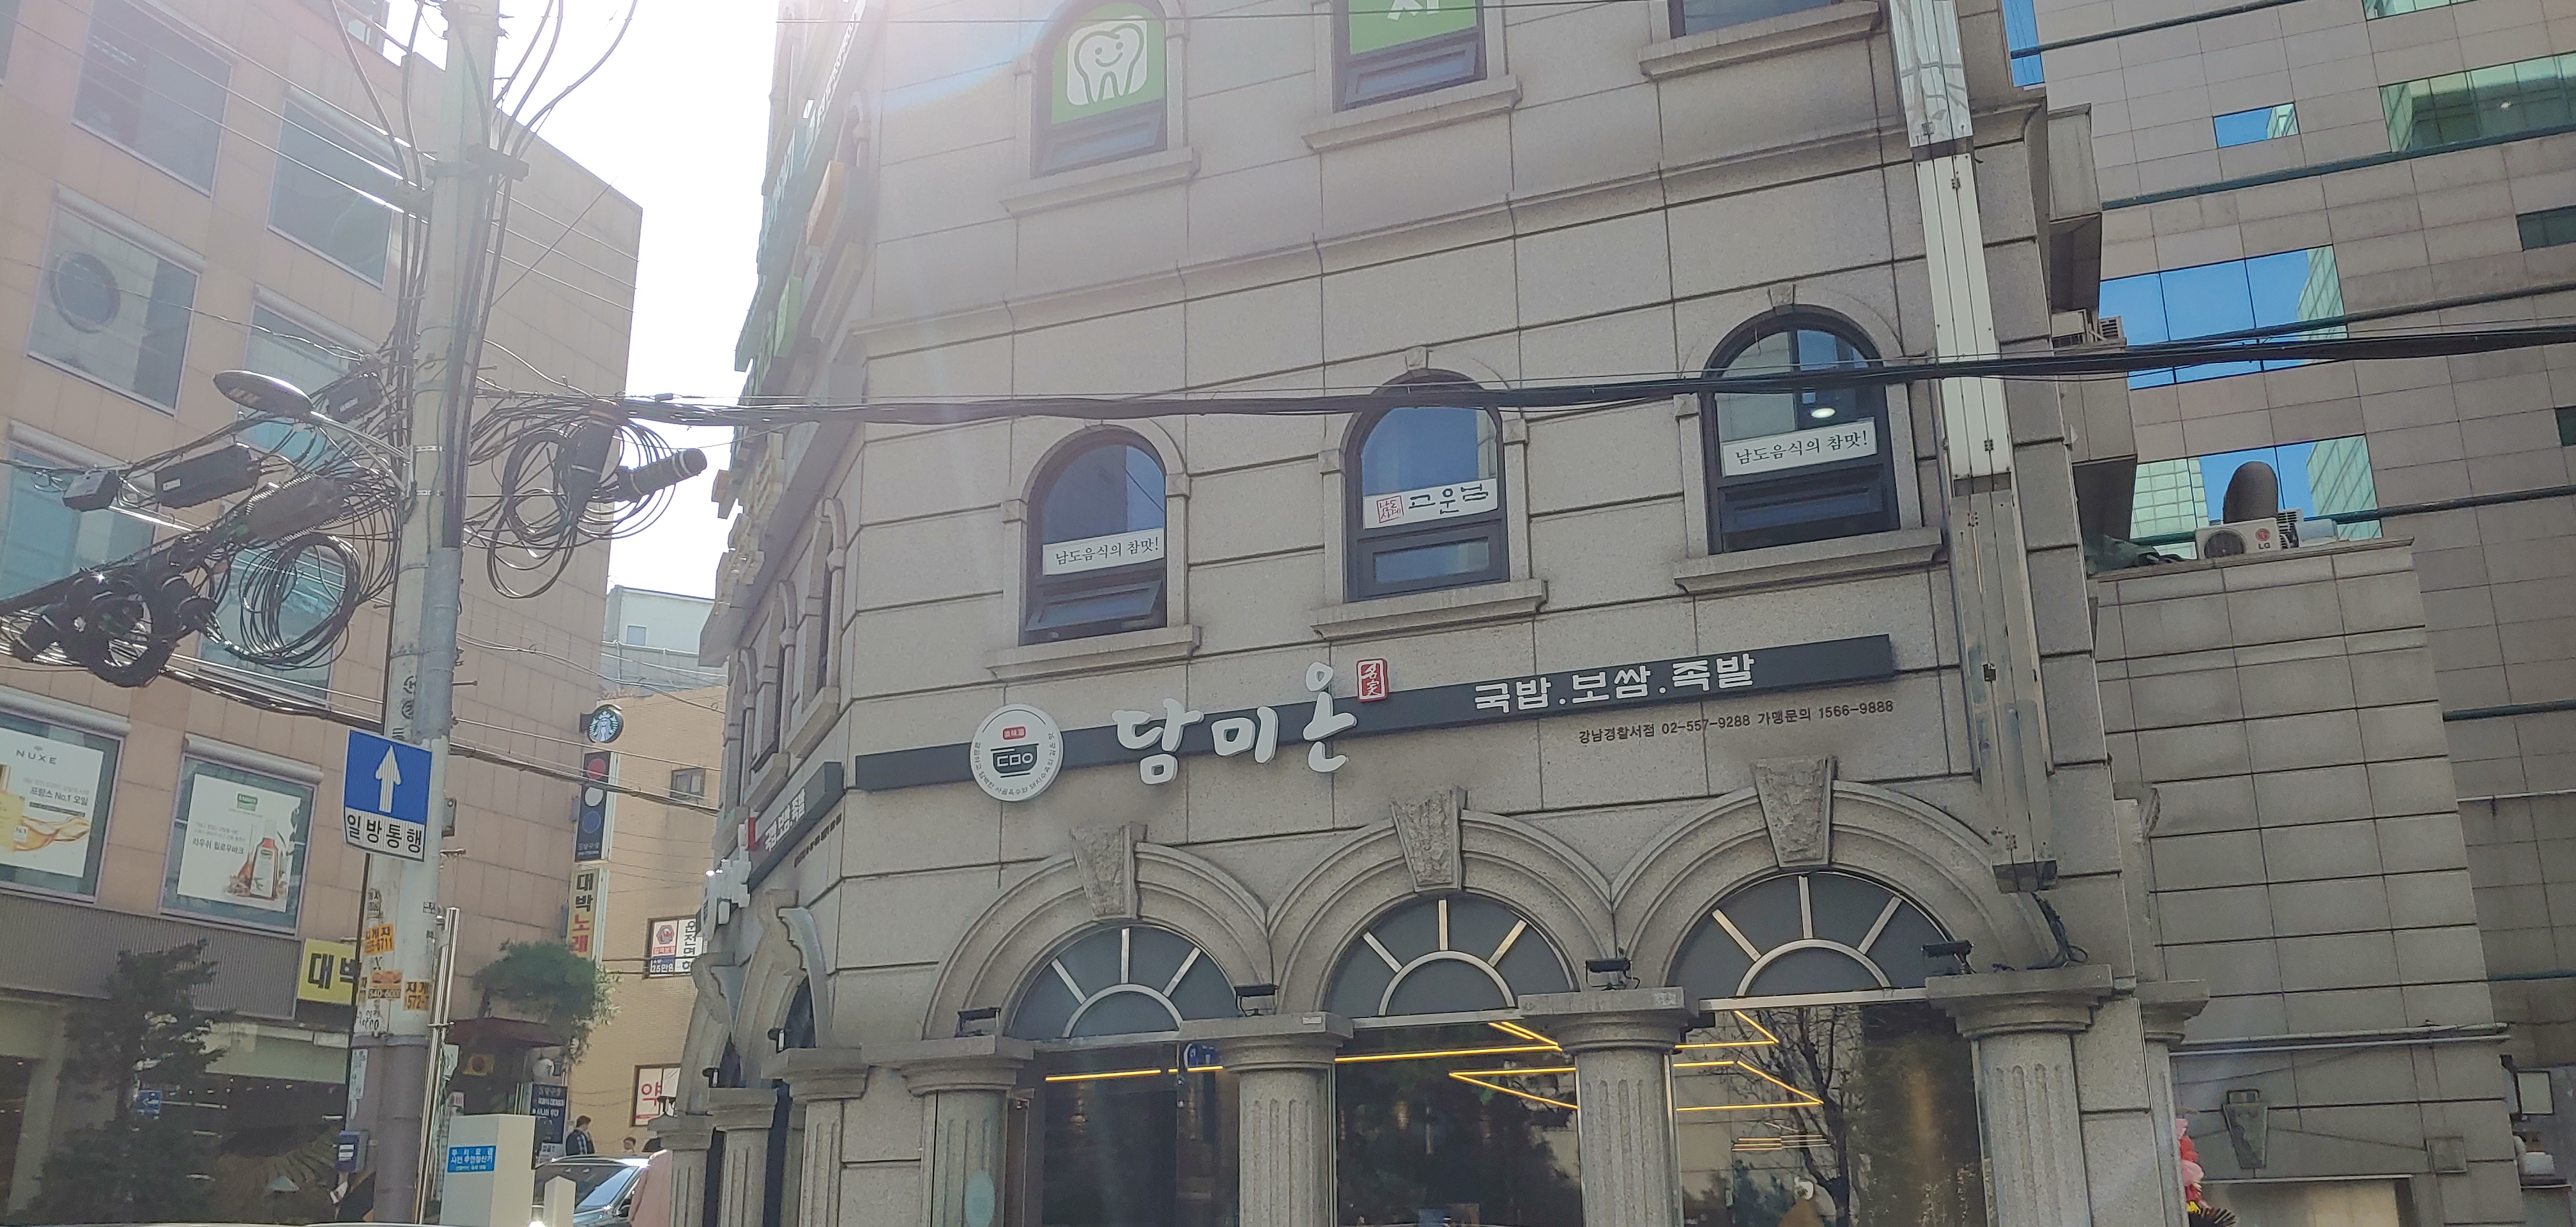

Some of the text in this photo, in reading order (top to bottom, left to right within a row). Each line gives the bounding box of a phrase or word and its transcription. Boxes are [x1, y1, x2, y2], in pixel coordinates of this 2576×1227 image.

[1735, 430, 1867, 465] 남도음식의 참맛!
[1055, 537, 1158, 566] 남도음식의 참맛!
[1112, 661, 1358, 784] 담미온
[1578, 700, 1894, 744] 강남경찰서점 02-557-9288 가맹문의 1566-9888
[16, 750, 57, 764] NUXE
[347, 815, 422, 853] 일방통행
